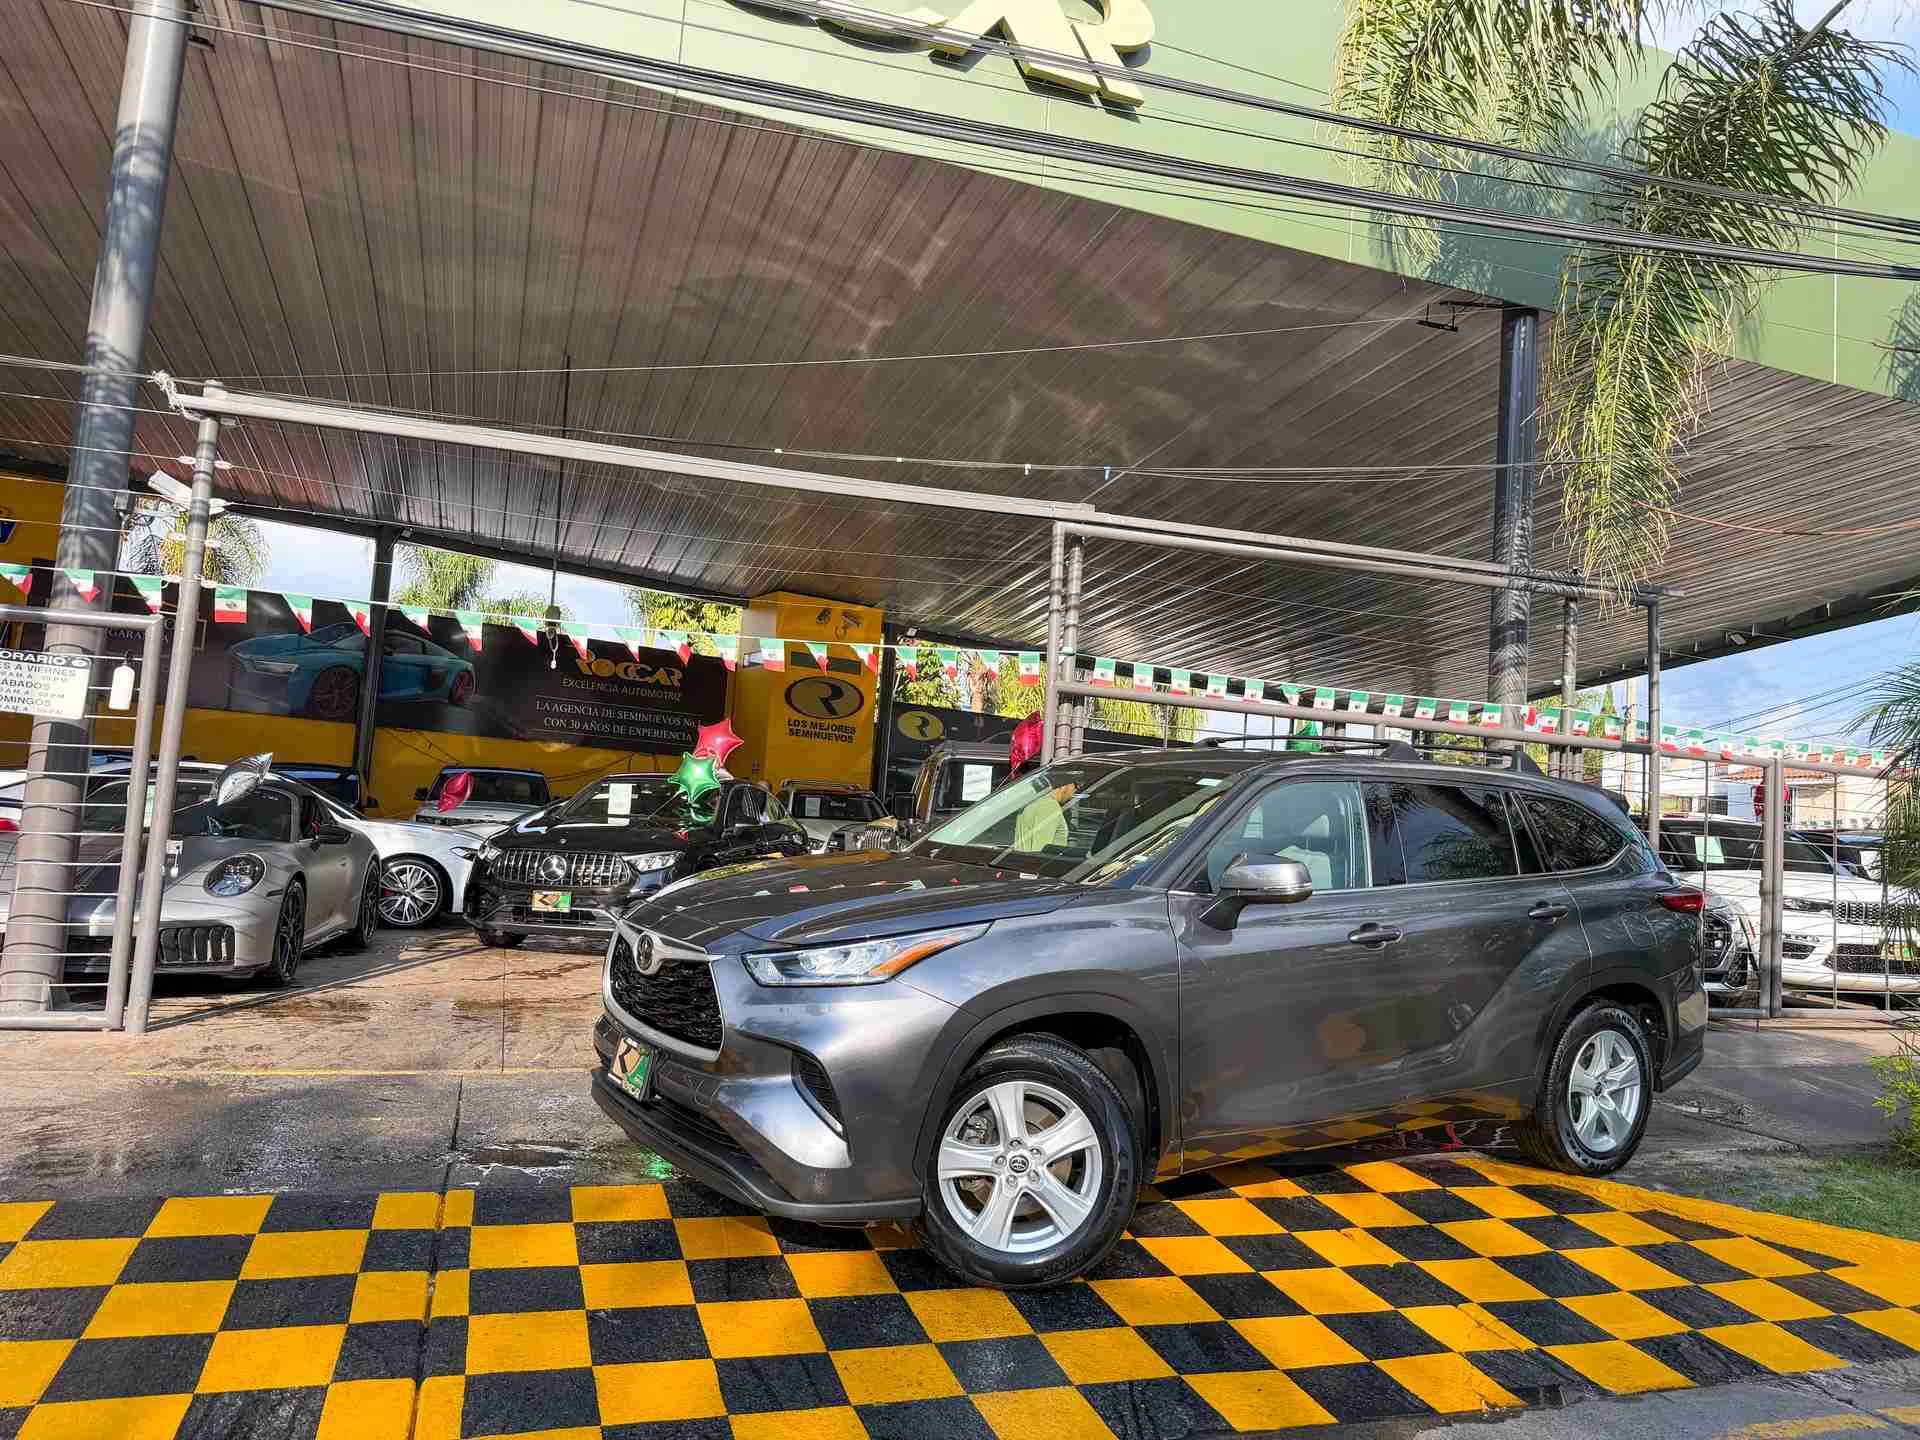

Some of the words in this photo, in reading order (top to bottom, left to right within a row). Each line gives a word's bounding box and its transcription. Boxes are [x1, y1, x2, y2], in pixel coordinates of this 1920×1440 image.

[0, 650, 67, 666] ORARIO
[0, 679, 50, 691] ABADOS
[562, 677, 620, 694] EXCELENCIA
[621, 686, 682, 703] AUTOMOTRIZ
[536, 700, 551, 712] LA
[552, 702, 600, 717] AGENCIA
[601, 707, 616, 719] DE
[617, 709, 681, 726] SEMINUEVOS
[544, 716, 567, 728] CON
[569, 718, 581, 729] 30
[612, 725, 627, 735] DE
[629, 726, 693, 742] EXPERIENCIA
[787, 719, 808, 730] LOS
[810, 720, 857, 735] MEJORES
[788, 728, 854, 744] SEMINUEVOS
